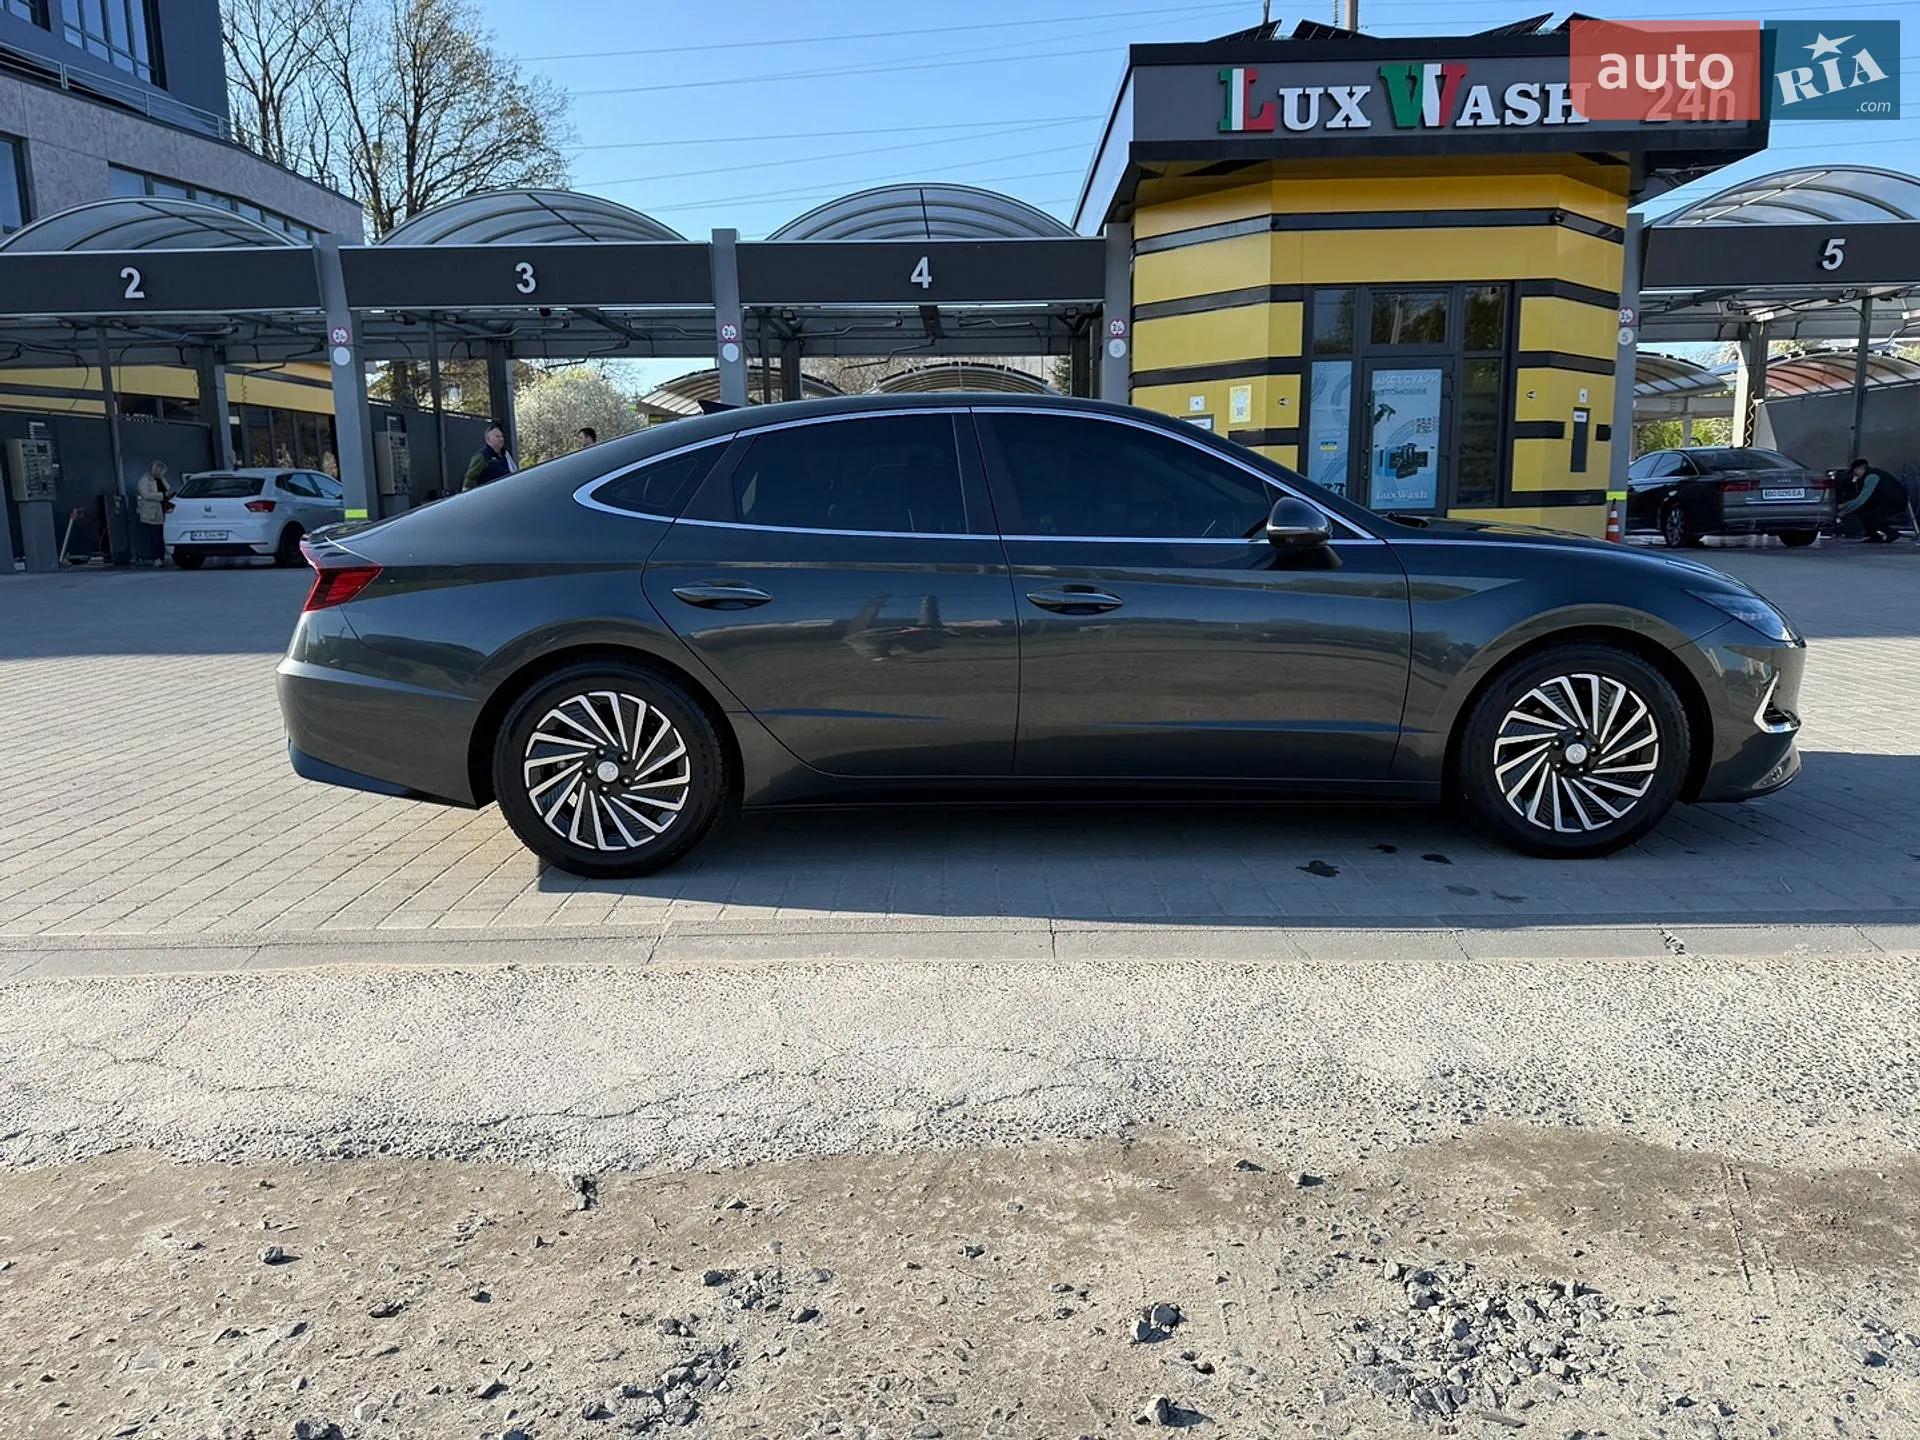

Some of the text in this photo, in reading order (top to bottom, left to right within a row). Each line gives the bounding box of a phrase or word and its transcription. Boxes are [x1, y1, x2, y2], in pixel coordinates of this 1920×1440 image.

[1822, 238, 1846, 271] 5
[120, 266, 145, 299] 2
[515, 261, 537, 294] 3
[910, 256, 933, 289] 4
[1375, 489, 1429, 500] LuxWash
